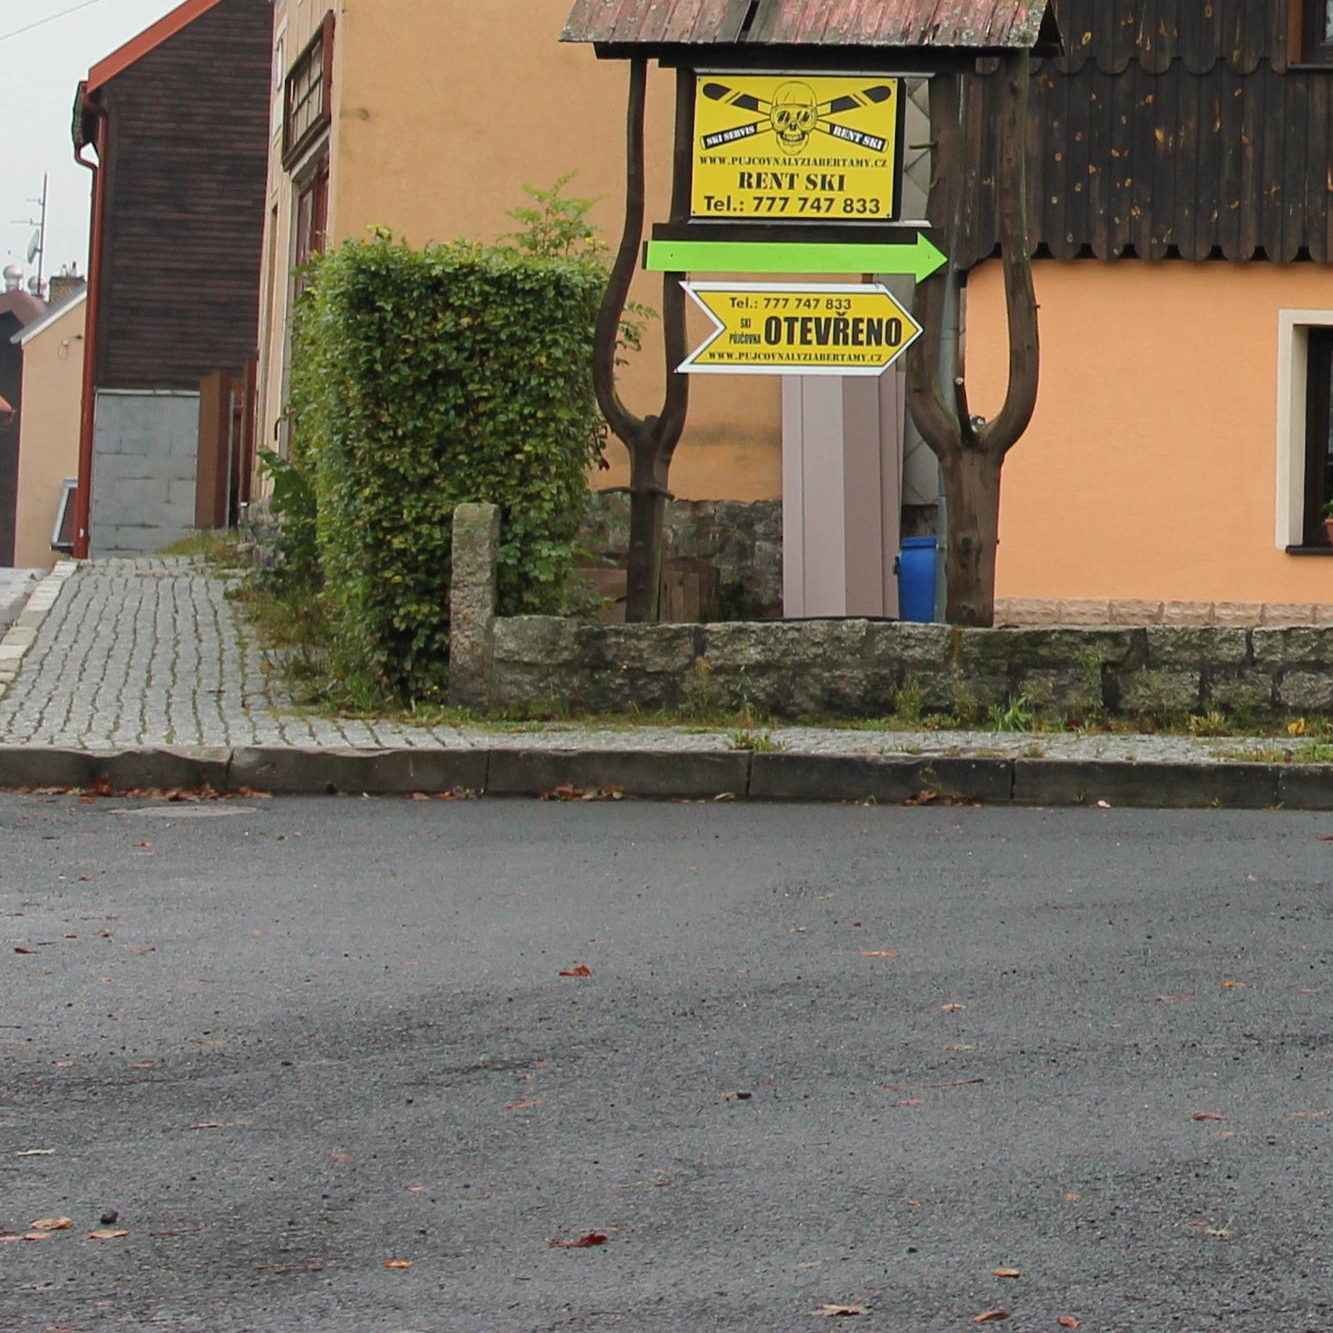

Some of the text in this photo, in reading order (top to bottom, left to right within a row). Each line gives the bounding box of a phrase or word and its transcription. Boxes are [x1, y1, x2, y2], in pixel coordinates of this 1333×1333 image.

[706, 125, 756, 147] SKI SERVIS
[832, 125, 883, 150] RENT SKI
[738, 171, 846, 192] RENT SKI
[704, 195, 881, 214] Tel.: 777 747 833
[729, 297, 852, 310] Tel.: 777 747 833
[764, 311, 903, 347] OTEVŘENO
